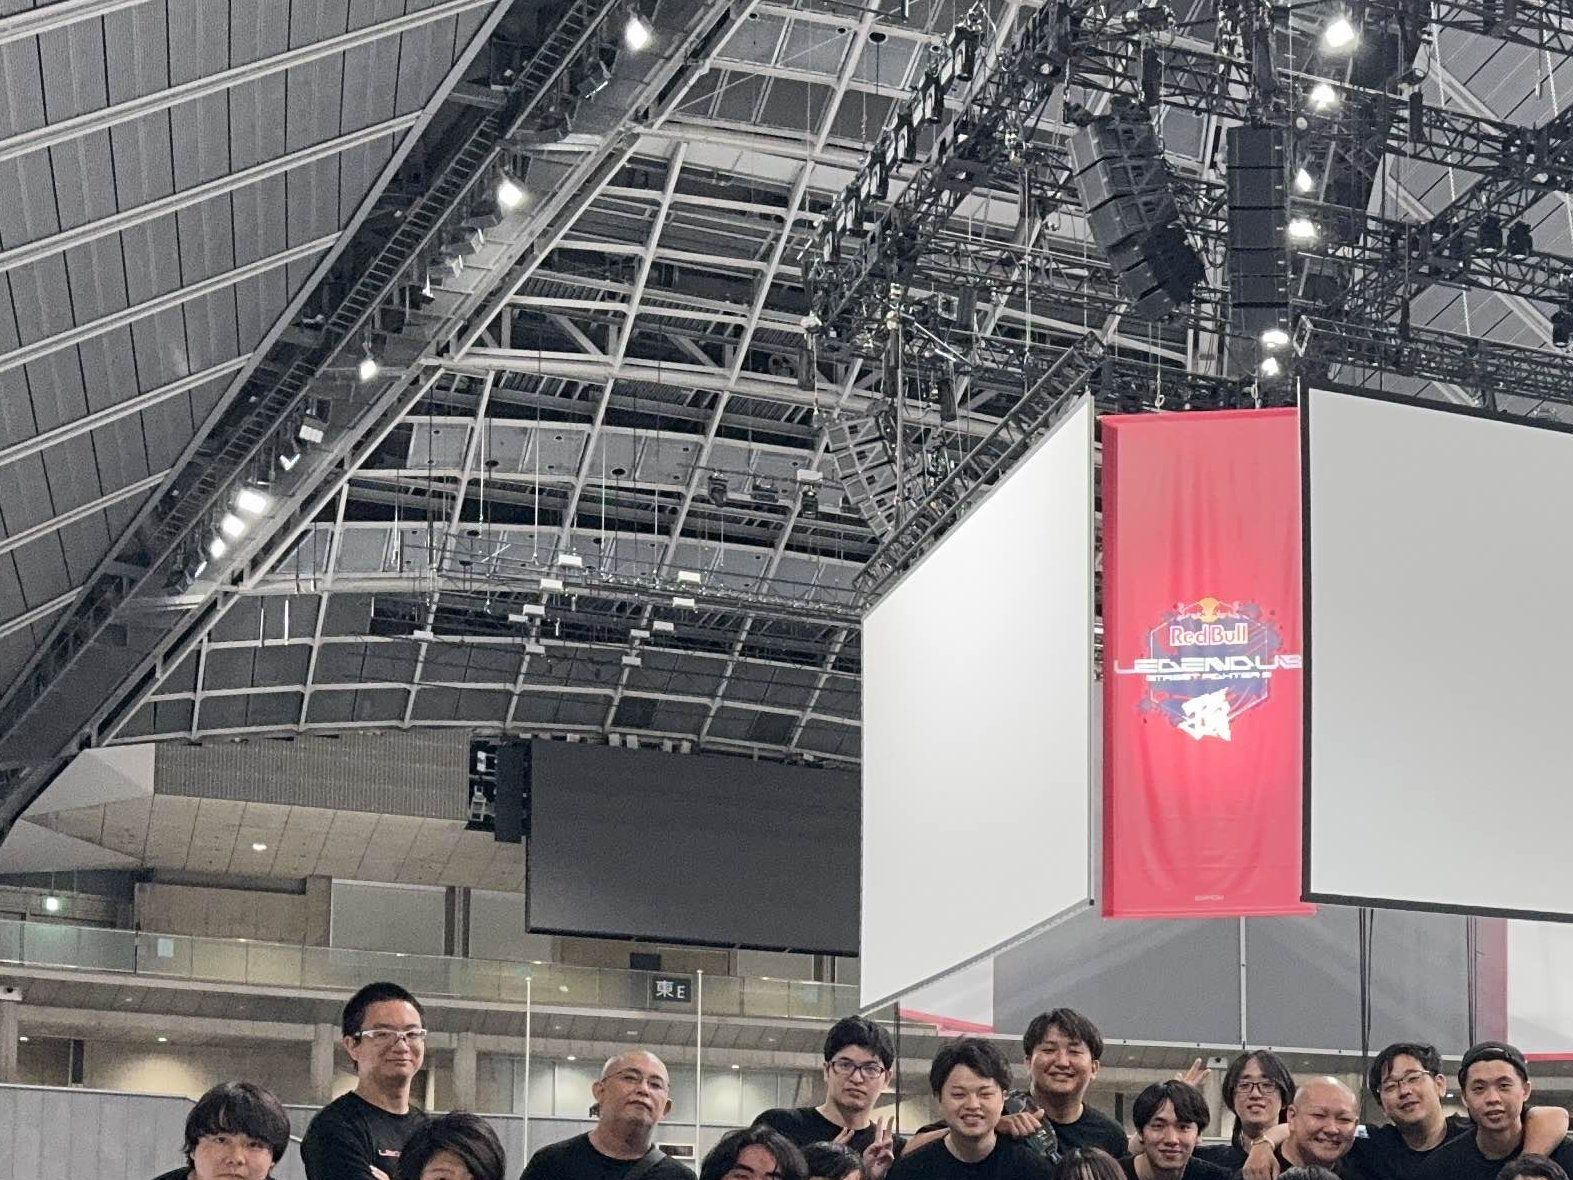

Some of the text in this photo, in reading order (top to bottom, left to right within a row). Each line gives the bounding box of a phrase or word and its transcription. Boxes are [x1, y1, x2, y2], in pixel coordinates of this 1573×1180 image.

[1169, 622, 1249, 646] Red Bull
[655, 980, 675, 998] 東
